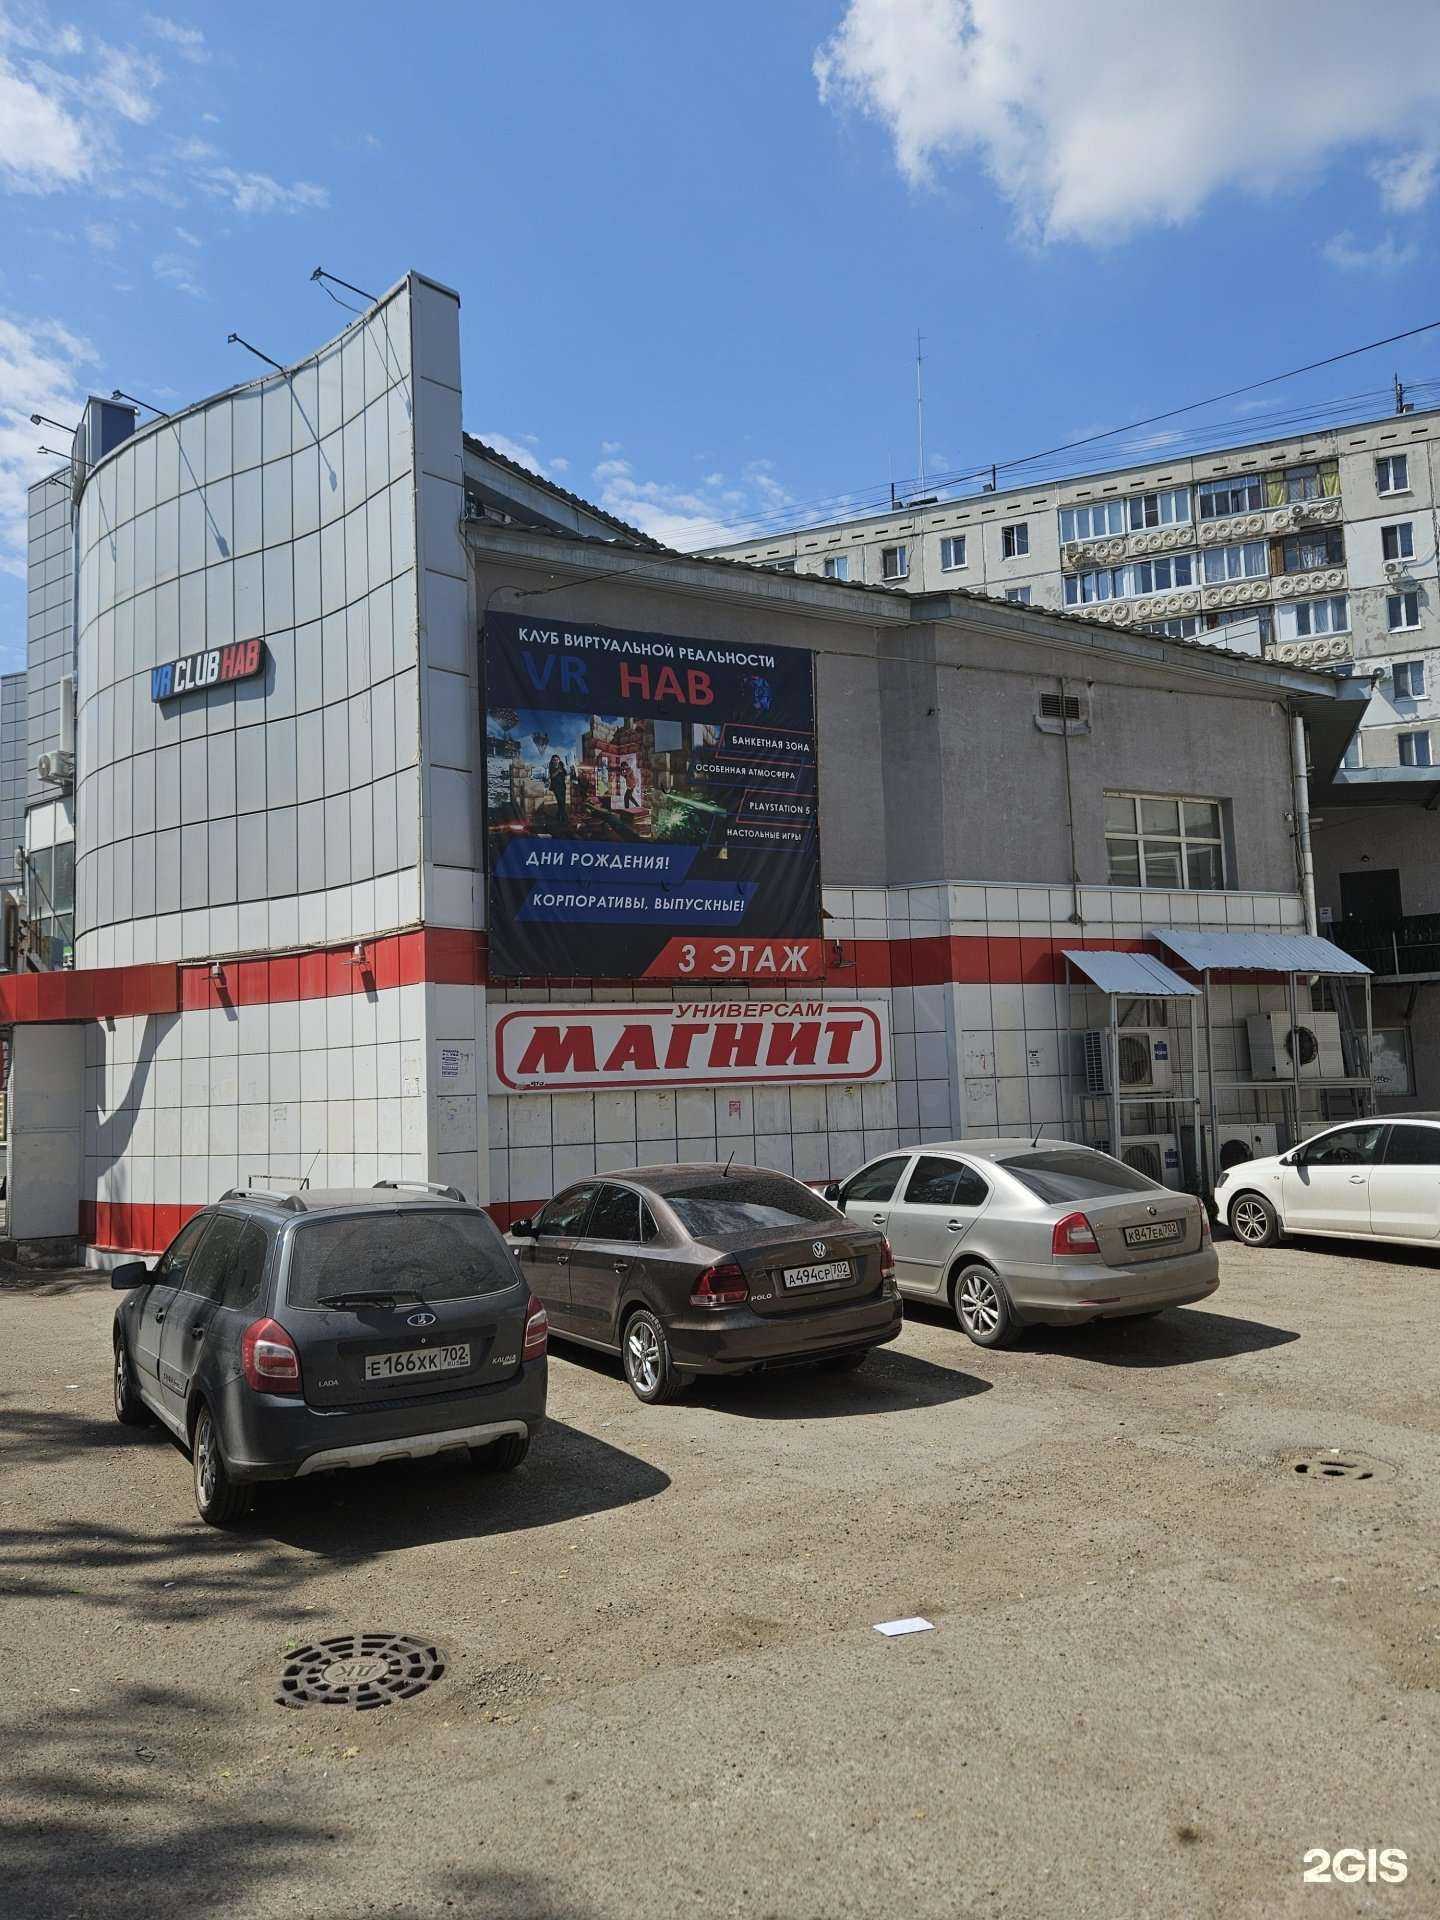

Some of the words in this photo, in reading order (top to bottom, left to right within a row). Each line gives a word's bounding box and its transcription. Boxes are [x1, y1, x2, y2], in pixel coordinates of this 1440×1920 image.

[518, 627, 560, 645] КЛУБ
[563, 633, 675, 659] ВИРТУАЛЬНОЙ
[679, 647, 775, 668] РЕАЛЬНОСТИ
[152, 663, 174, 700] VR
[173, 651, 220, 693] CLUB
[221, 640, 260, 680] HAB
[520, 650, 590, 695] VR
[619, 661, 715, 706] HAB
[731, 735, 784, 750] БАНКЕТНАЯ
[785, 741, 810, 752] ЗОНА
[695, 763, 746, 775] ОСОБЕННАЯ
[748, 768, 796, 780] АТМОСФЕРА
[749, 801, 803, 814] PLAYSTATION
[726, 828, 780, 840] НАСТОЛЬНЫЕ
[781, 832, 802, 841] ИГРЫ
[525, 851, 564, 866] ДНИ
[570, 853, 670, 870] РОЖДЕНИЯ!
[533, 894, 648, 910] КОРПОРАТИВЫ,
[654, 897, 745, 912] ВЫПУСКНЫЕ!
[678, 944, 696, 973] 3
[711, 944, 809, 973] ЭТАЖ
[675, 1003, 824, 1018] УНИВЕРСАМ
[517, 1020, 864, 1074] МАГНИТ
[751, 1293, 773, 1302] POLO
